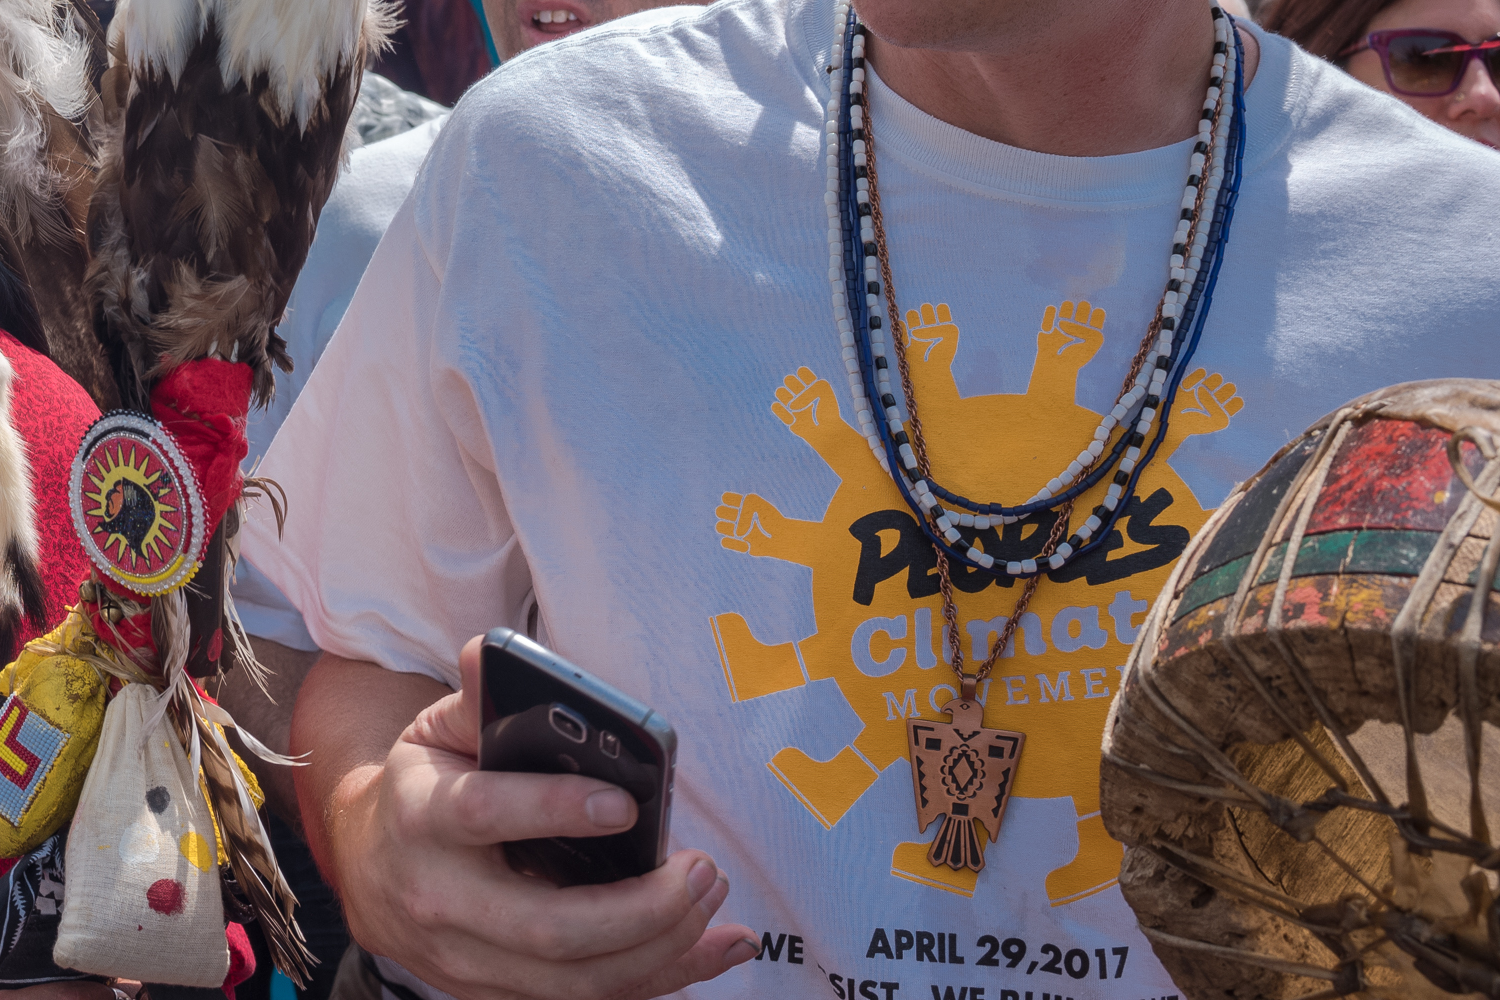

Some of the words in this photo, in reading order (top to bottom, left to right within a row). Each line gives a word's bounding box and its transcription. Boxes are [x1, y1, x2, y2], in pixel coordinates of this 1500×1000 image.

[851, 590, 1148, 678] Climat
[882, 664, 1126, 721] MOEME
[755, 931, 804, 965] WE
[866, 927, 965, 965] APRIL
[976, 934, 1129, 980] 29,2017
